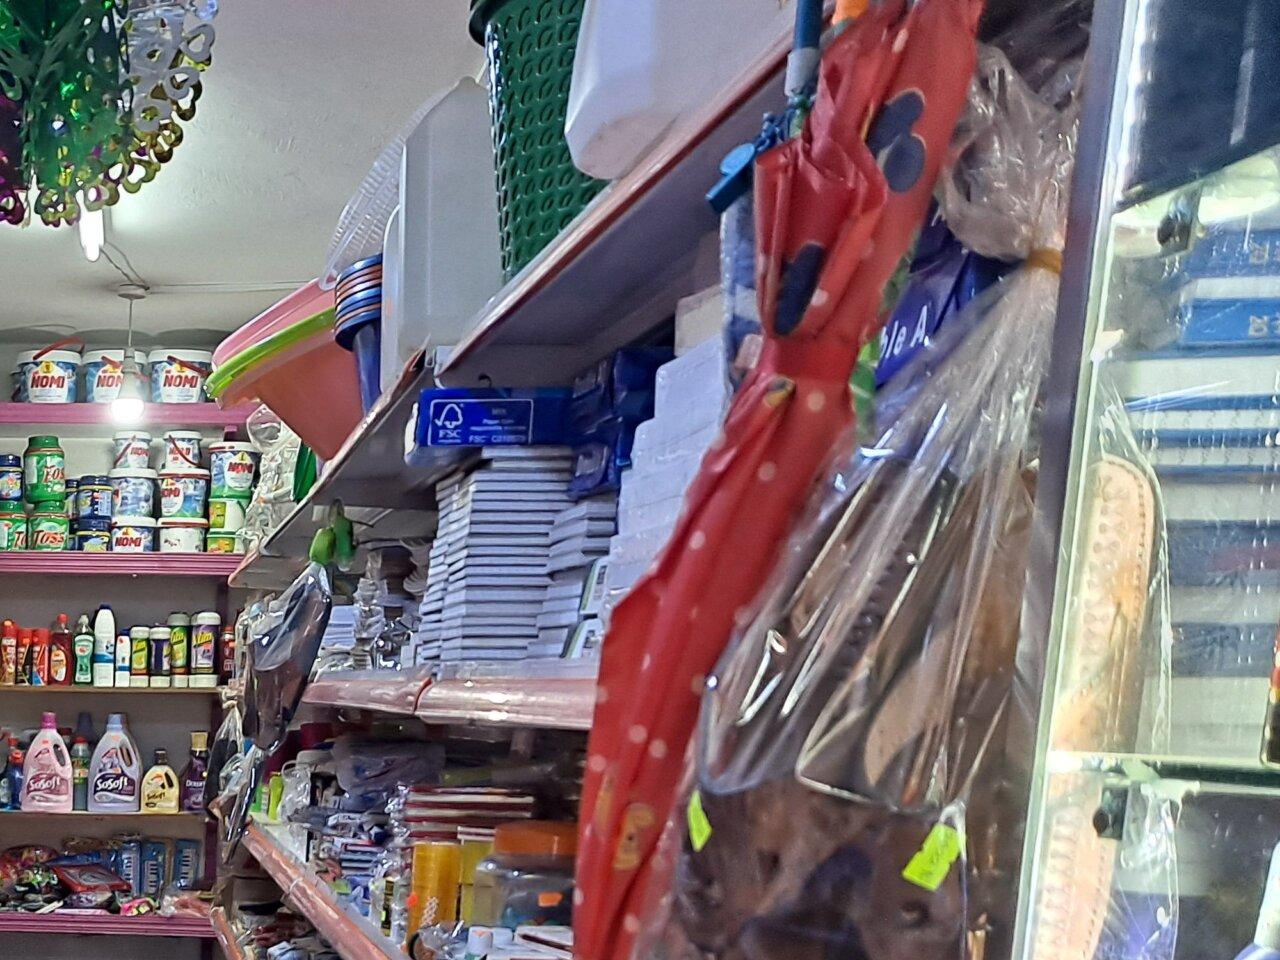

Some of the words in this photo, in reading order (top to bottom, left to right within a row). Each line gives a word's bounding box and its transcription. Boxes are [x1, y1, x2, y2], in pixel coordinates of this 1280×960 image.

[30, 374, 65, 389] NOMI
[96, 374, 125, 388] NOM
[163, 374, 198, 389] NOMI
